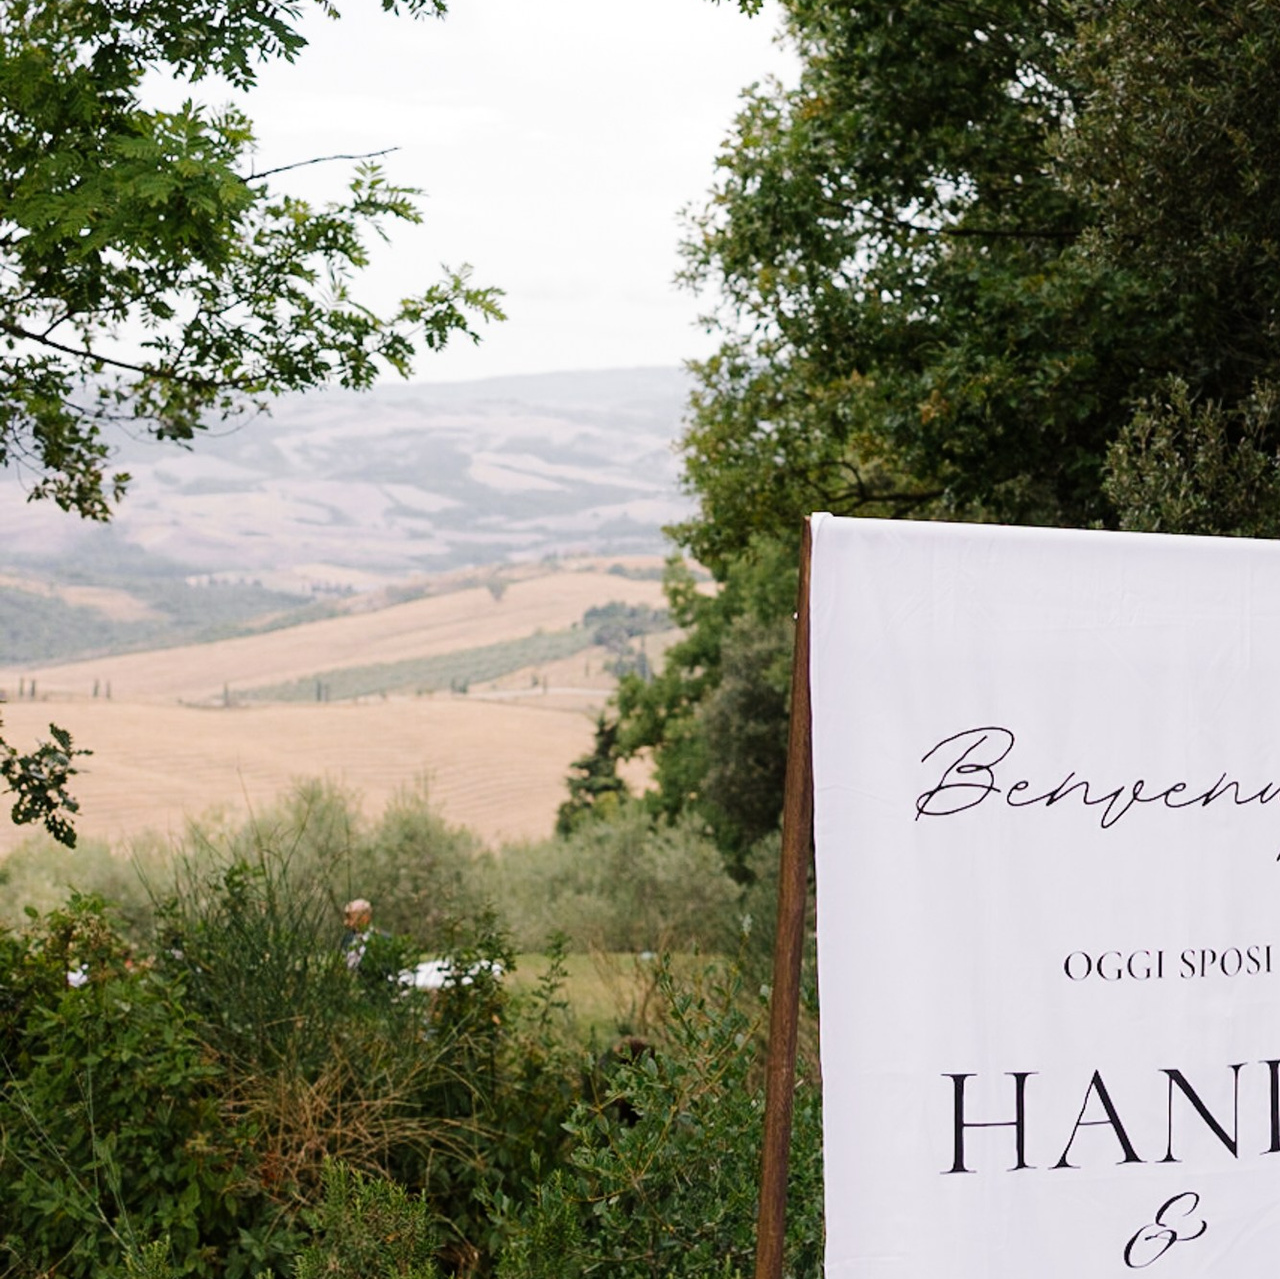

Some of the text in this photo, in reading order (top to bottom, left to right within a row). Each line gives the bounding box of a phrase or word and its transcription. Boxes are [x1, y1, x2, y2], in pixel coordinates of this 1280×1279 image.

[1064, 945, 1272, 981] OGGI SPOSI
[1124, 1192, 1207, 1269] &
